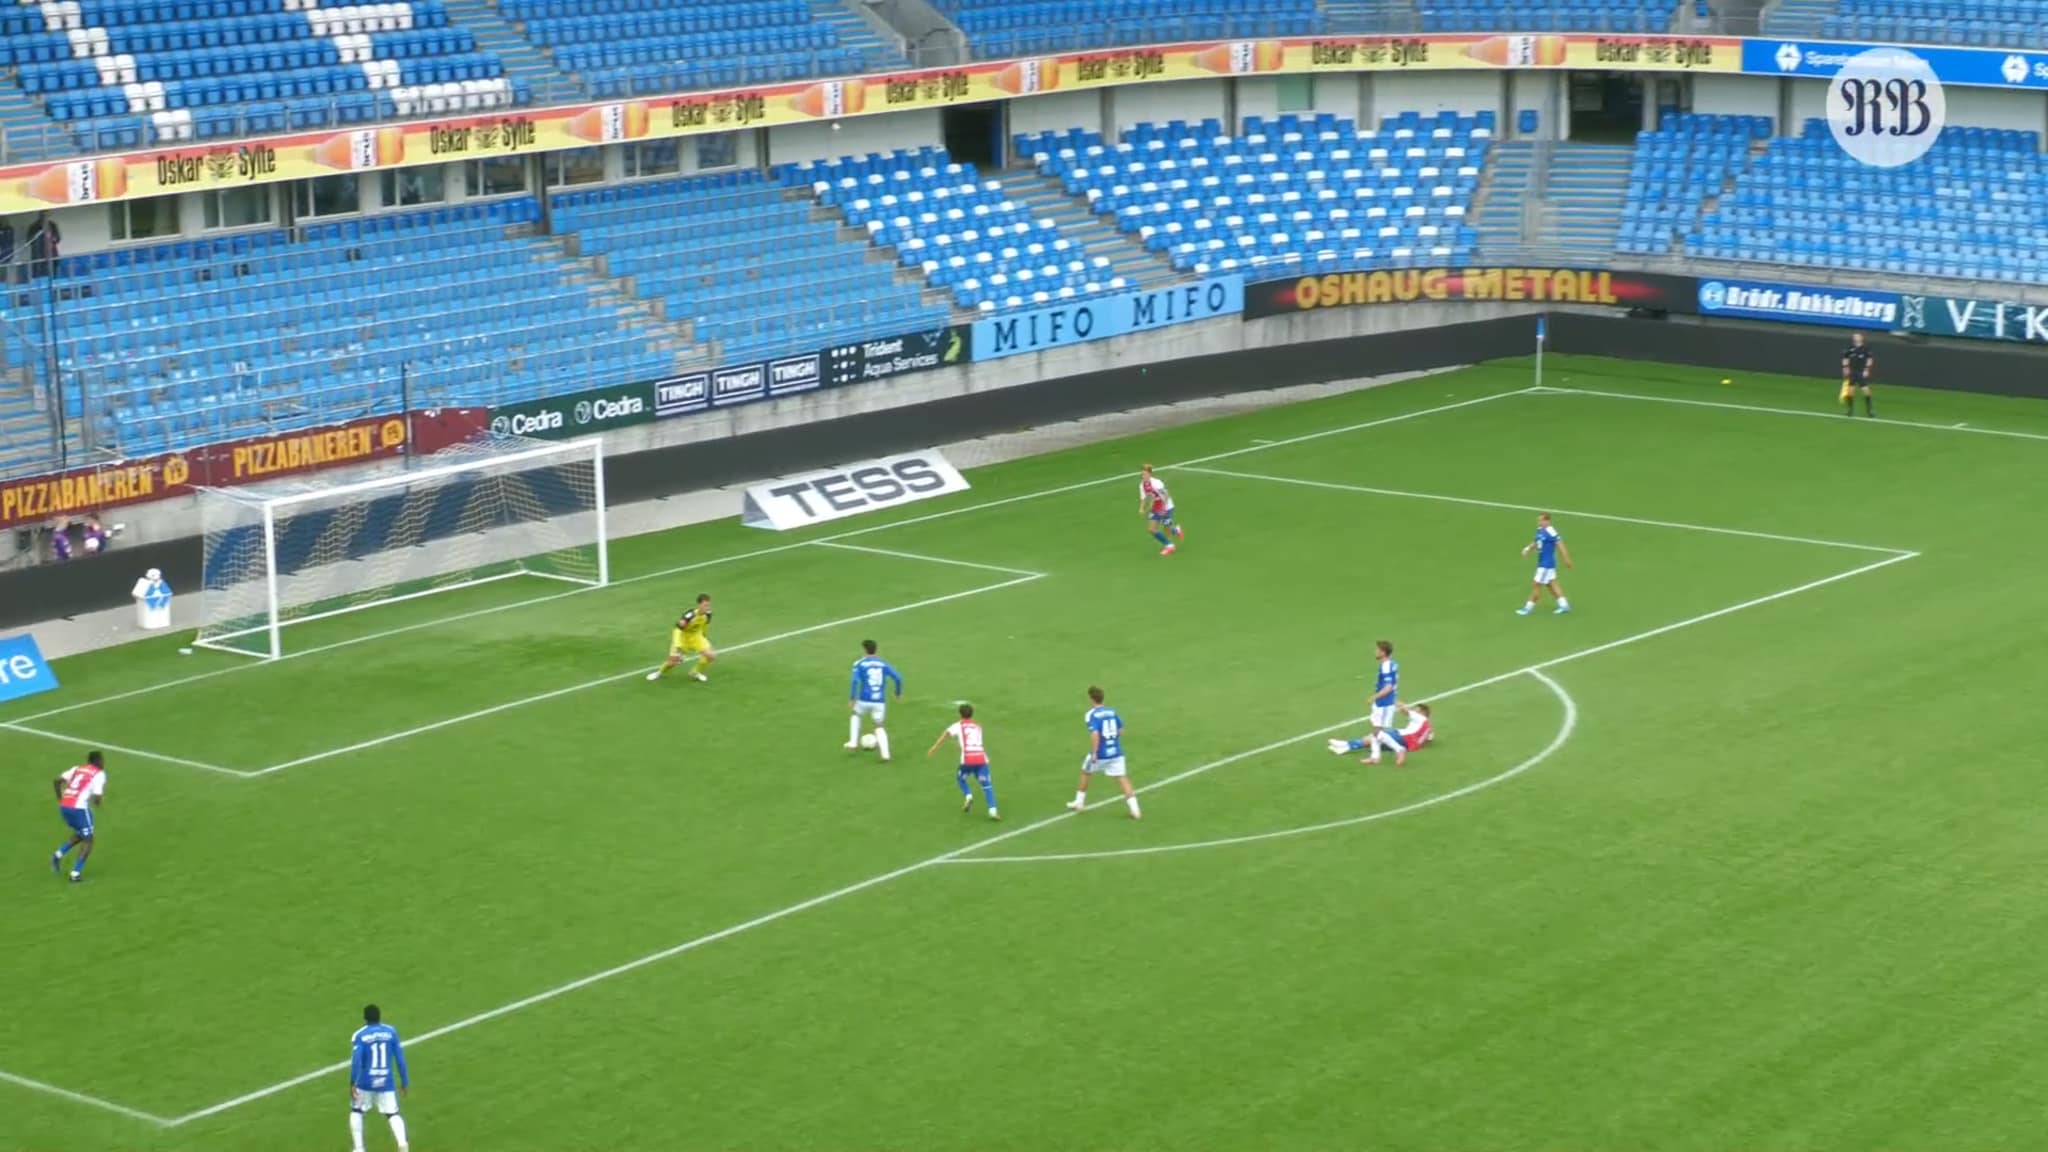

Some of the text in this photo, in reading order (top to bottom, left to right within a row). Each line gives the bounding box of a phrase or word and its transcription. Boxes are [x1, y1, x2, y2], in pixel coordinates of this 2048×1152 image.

[430, 117, 536, 154] Oskar Sylte
[157, 144, 276, 186] Oskar Sylte
[1295, 268, 1617, 310] OSHAUG METALL
[994, 282, 1226, 353] MIFO MIFO
[862, 339, 904, 358] Trident
[863, 353, 939, 378] Aqua Services
[512, 410, 563, 435] Cedra
[593, 396, 643, 420] Cedra
[233, 425, 373, 478] PIZZABAKEREN
[2, 464, 153, 521] PIZZABAKEREN
[768, 458, 946, 518] TESS
[371, 1042, 387, 1069] 11
